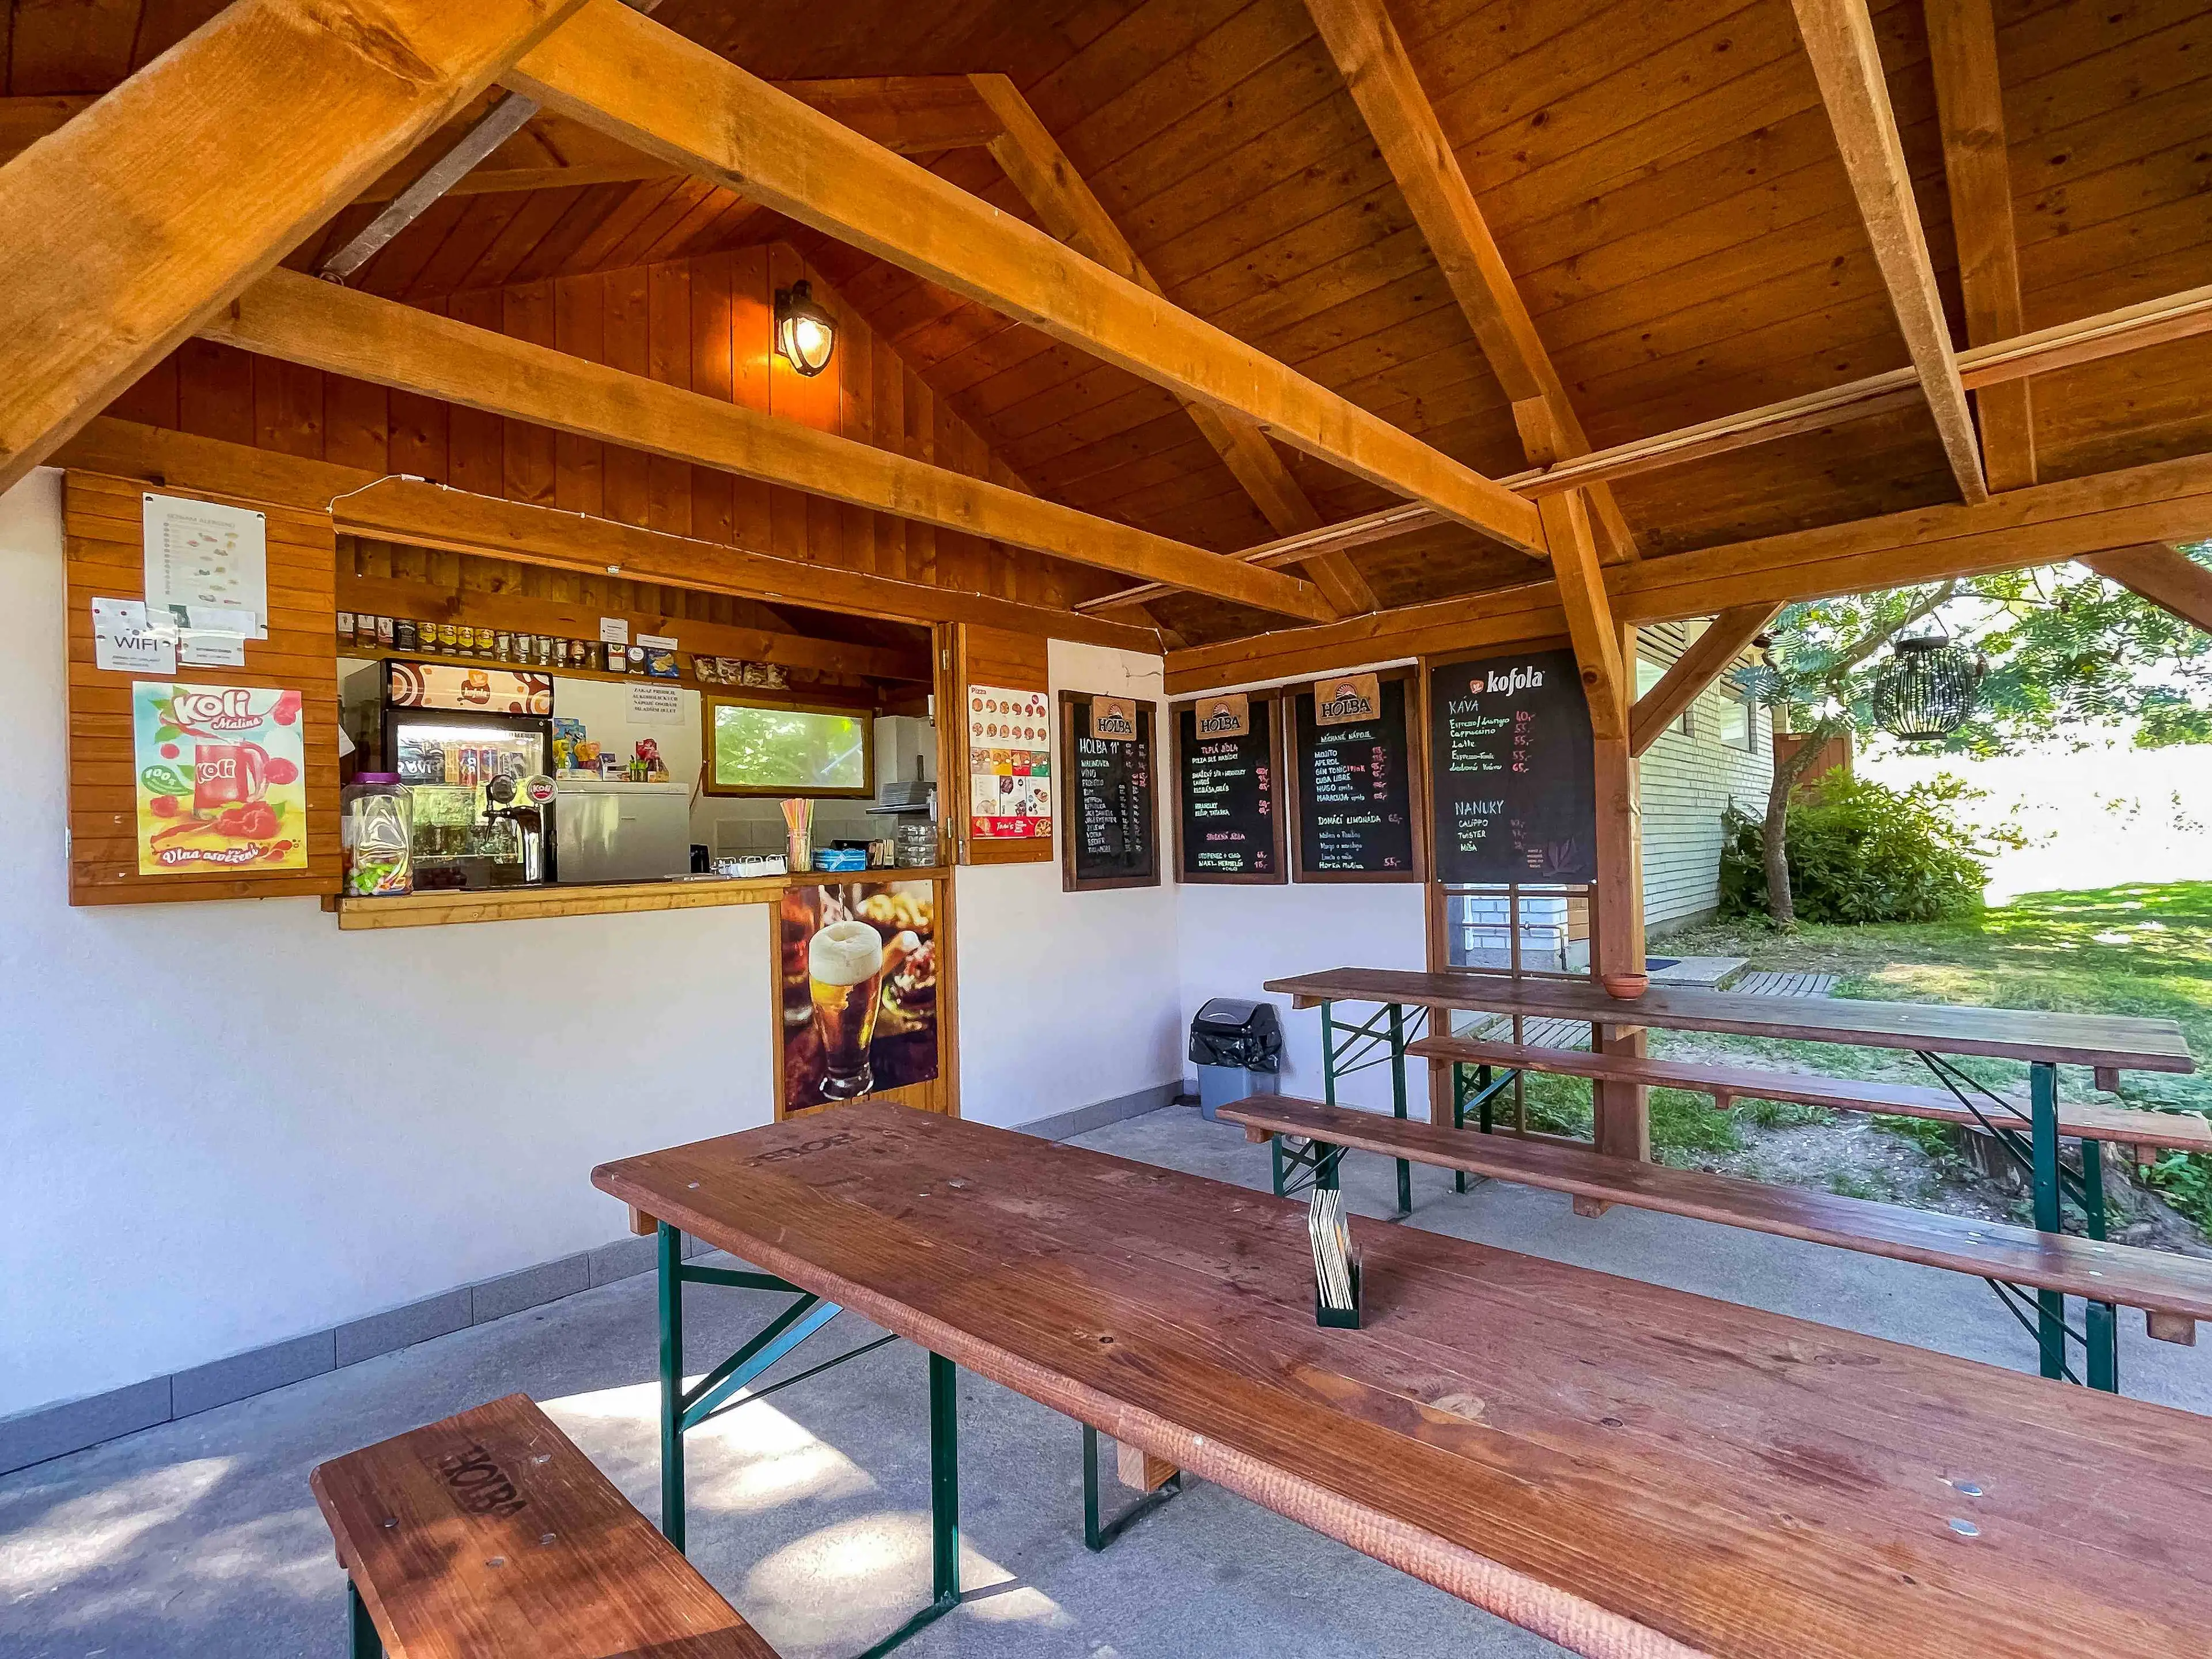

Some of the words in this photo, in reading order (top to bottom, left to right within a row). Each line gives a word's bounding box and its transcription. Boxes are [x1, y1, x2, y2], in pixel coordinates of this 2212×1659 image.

[115, 635, 157, 652] WIFI
[1487, 666, 1543, 697] kofola
[971, 687, 987, 695] Pizza
[1321, 698, 1373, 718] HOLBA
[1449, 696, 1479, 715] KÁVA
[1097, 718, 1132, 734] HOLBA
[1201, 716, 1241, 733] HOLBA
[1080, 738, 1107, 754] HOLBA
[1455, 800, 1505, 816] NANUKY
[1317, 813, 1344, 825] DOMÁCÍ
[1346, 810, 1381, 824] LIMONÁDA
